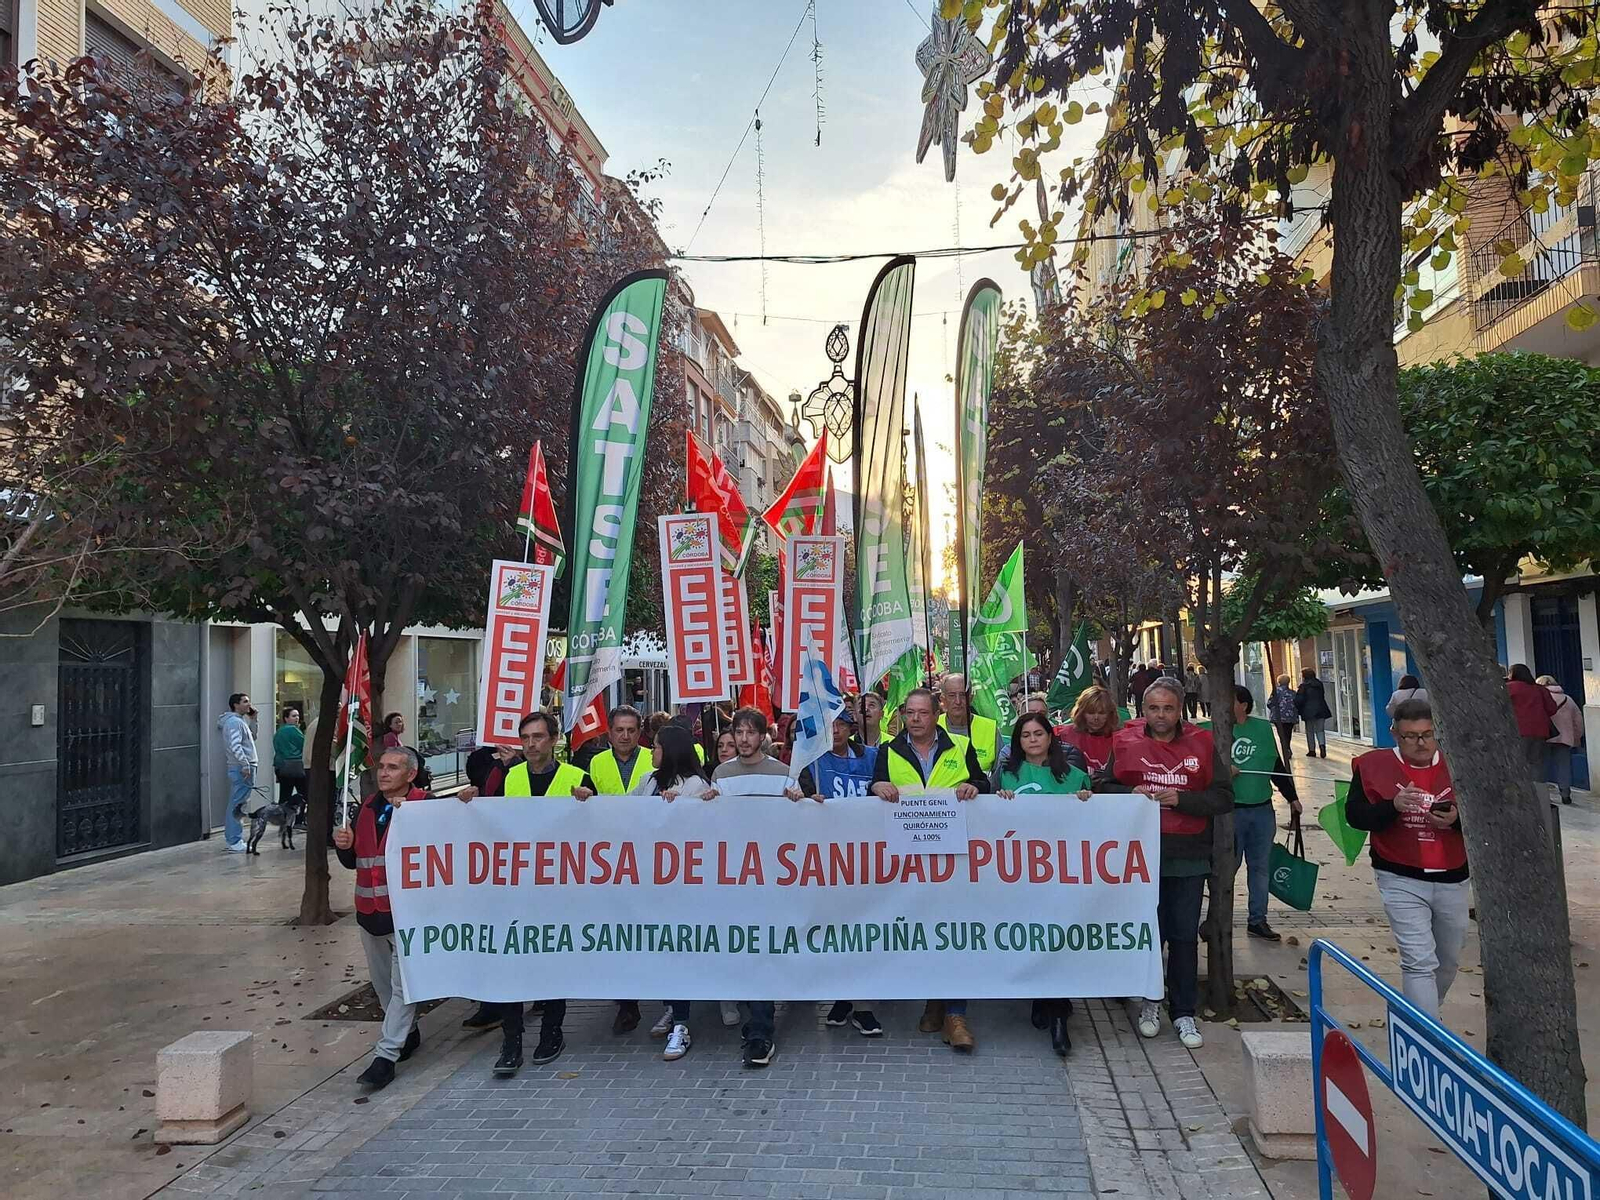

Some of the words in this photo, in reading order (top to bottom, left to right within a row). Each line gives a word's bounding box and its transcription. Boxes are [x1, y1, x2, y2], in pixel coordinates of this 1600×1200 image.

[679, 574, 713, 690] CCOO
[493, 622, 531, 738] CCOO
[1055, 660, 1071, 687] SIF
[1235, 745, 1257, 755] CSIF
[893, 810, 957, 818] FUNCIONAMIENTO
[902, 822, 949, 830] QUIRÓFANOS
[400, 843, 454, 889] EN
[468, 841, 640, 886] DEFENSA
[653, 841, 704, 886] DE
[717, 841, 765, 886] LA
[776, 841, 956, 887] SANIDAD
[968, 831, 1152, 885] PÚBLICA
[399, 927, 416, 957] Y
[423, 923, 473, 954] POR
[478, 924, 498, 955] EL
[503, 919, 574, 955] ÁREA
[580, 923, 720, 954] SANITARIA
[728, 924, 760, 954] DE
[768, 925, 799, 954] LA
[806, 916, 929, 954] CAMPIÑA
[934, 922, 988, 951] SUR
[994, 921, 1153, 952] CORDOBESA
